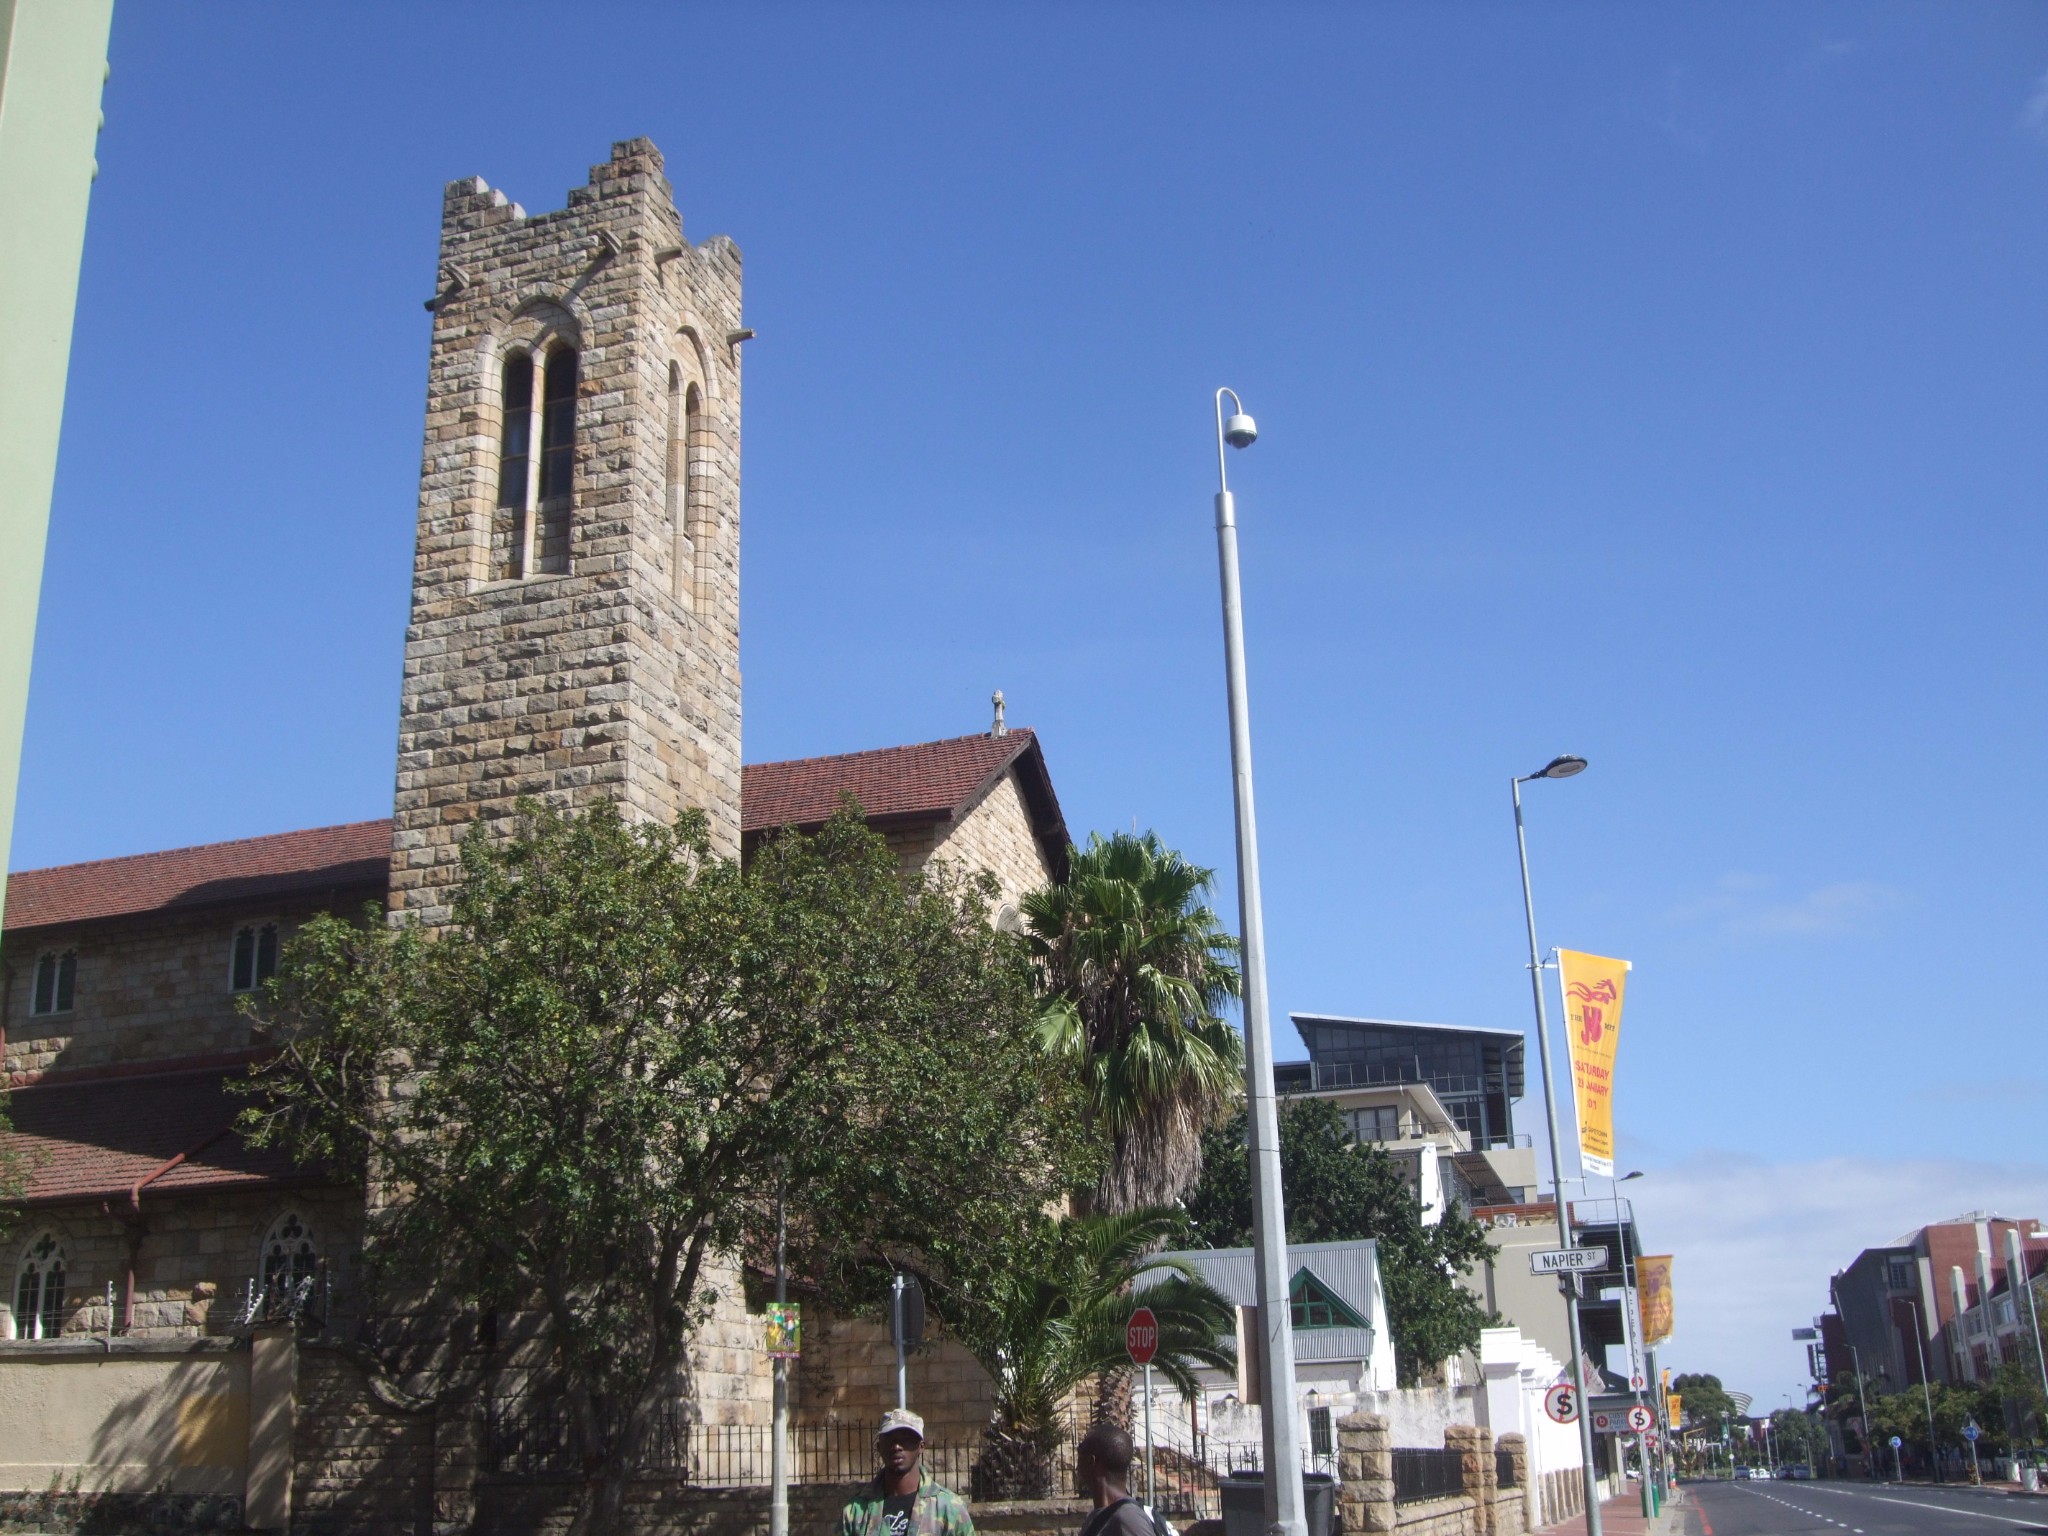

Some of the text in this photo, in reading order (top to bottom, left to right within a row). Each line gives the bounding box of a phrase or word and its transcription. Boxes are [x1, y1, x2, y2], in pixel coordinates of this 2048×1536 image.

[1575, 1060, 1610, 1081] SATURDAY
[1542, 1251, 1596, 1268] NAPIER ST
[1130, 1326, 1155, 1348] STOP
